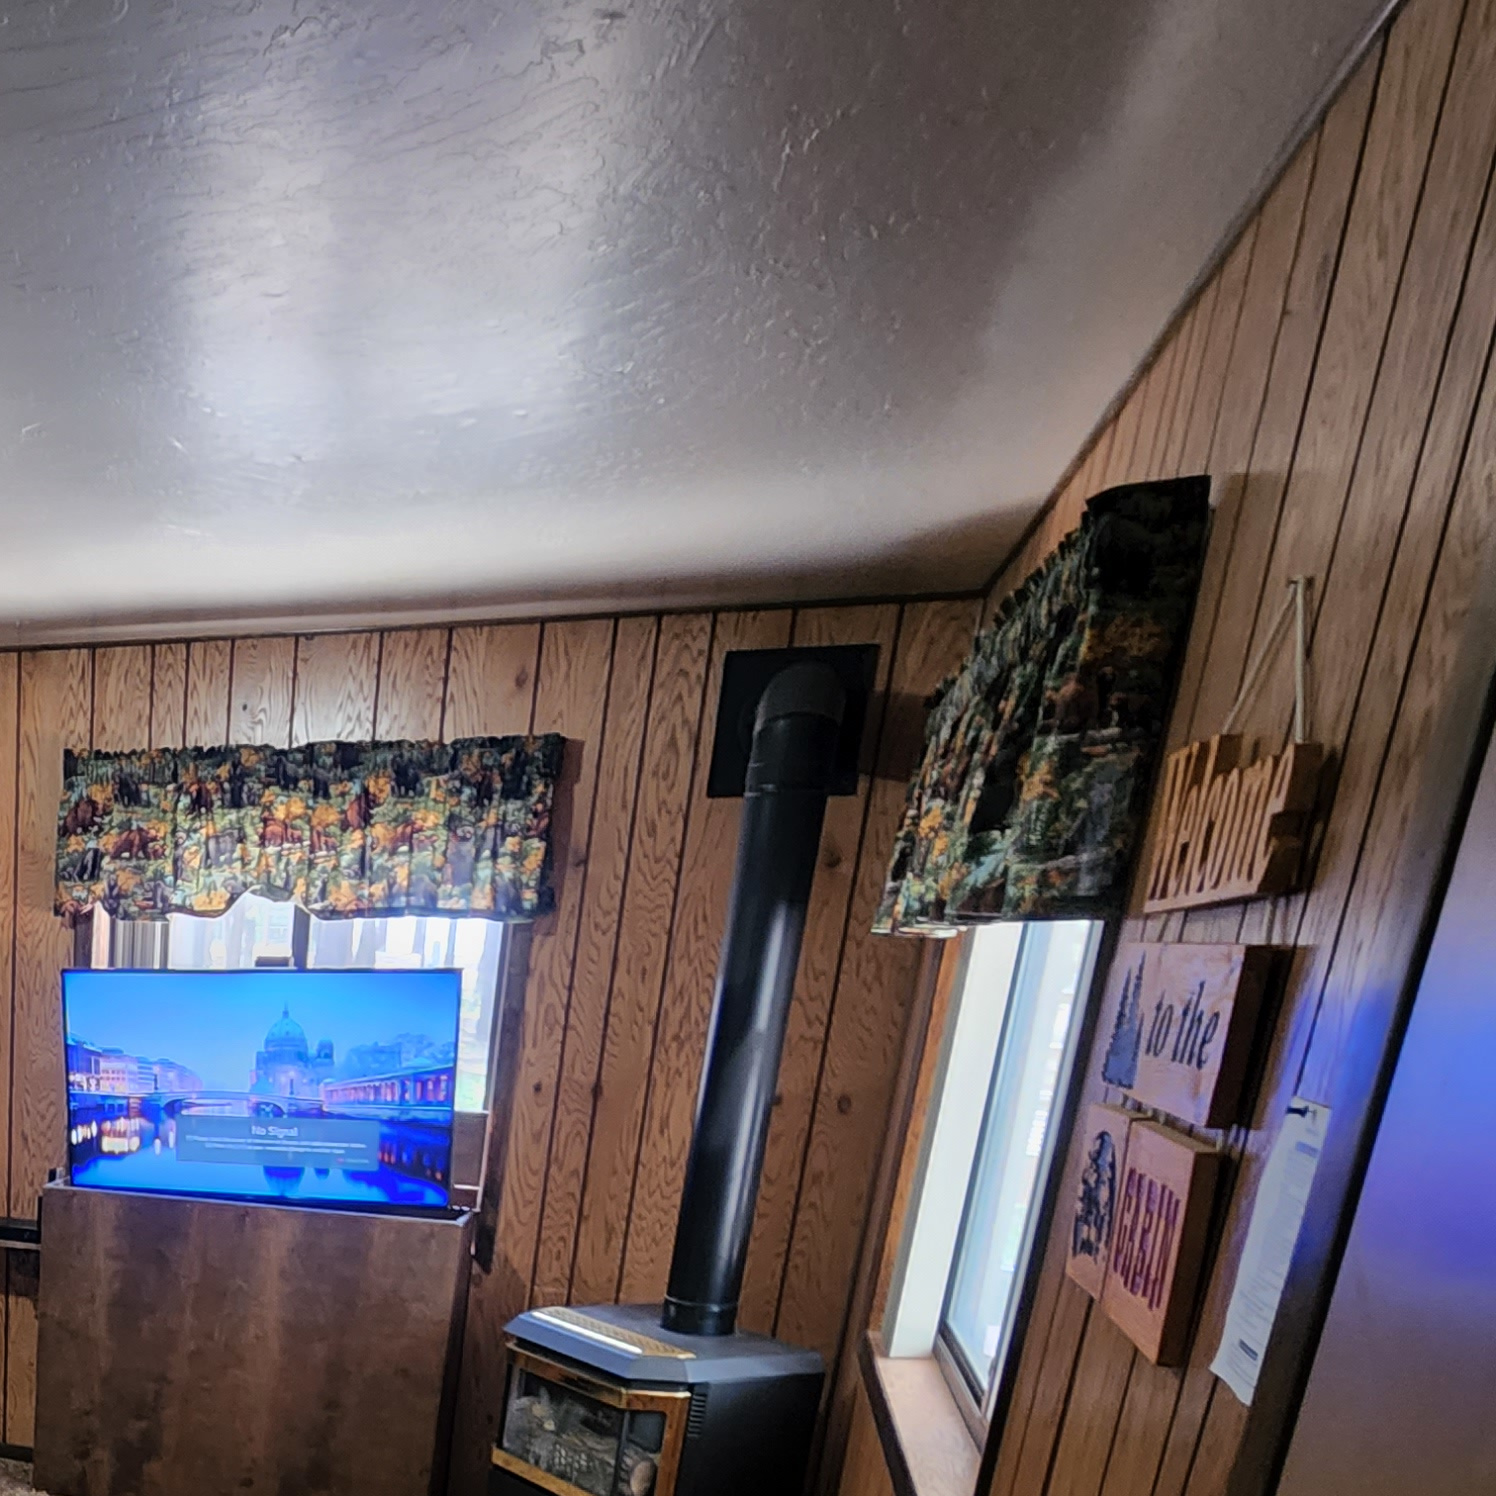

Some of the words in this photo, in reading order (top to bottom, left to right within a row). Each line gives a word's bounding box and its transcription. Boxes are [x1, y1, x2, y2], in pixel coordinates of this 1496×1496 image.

[1147, 734, 1295, 901] Welcome
[1144, 988, 1175, 1058] to
[1170, 979, 1221, 1071] the
[251, 1125, 267, 1136] No
[268, 1126, 299, 1139] Signal
[1113, 1166, 1181, 1312] CABIN
